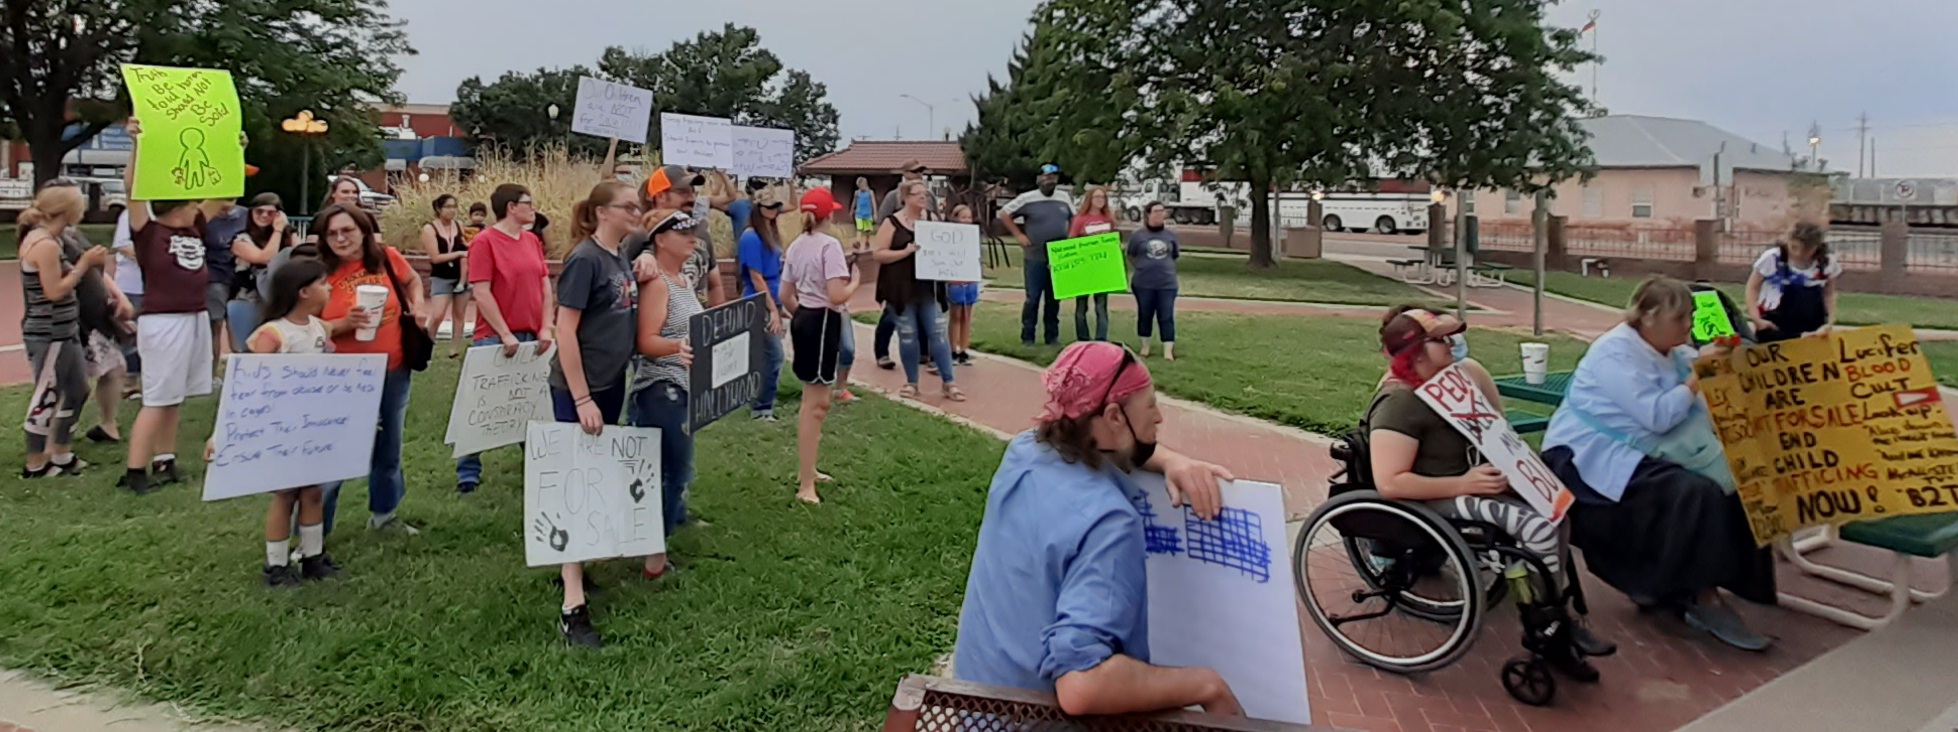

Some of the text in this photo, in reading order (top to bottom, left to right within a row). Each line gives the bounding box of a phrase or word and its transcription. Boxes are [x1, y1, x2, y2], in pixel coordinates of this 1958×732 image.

[931, 229, 964, 245] GOD
[702, 301, 756, 347] DEFUND
[1746, 344, 1789, 367] OUR
[1839, 334, 1920, 363] Lucifer
[1844, 358, 1911, 383] BLOOD
[696, 371, 760, 422] HOLLYWOOD
[1765, 388, 1806, 411] ARE
[1851, 377, 1910, 399] CULT
[529, 429, 561, 460] WE
[611, 436, 648, 458] NOT
[1779, 432, 1817, 451] END
[1773, 449, 1839, 474] CHILD
[538, 467, 608, 516] FOR
[587, 507, 648, 547] SALE
